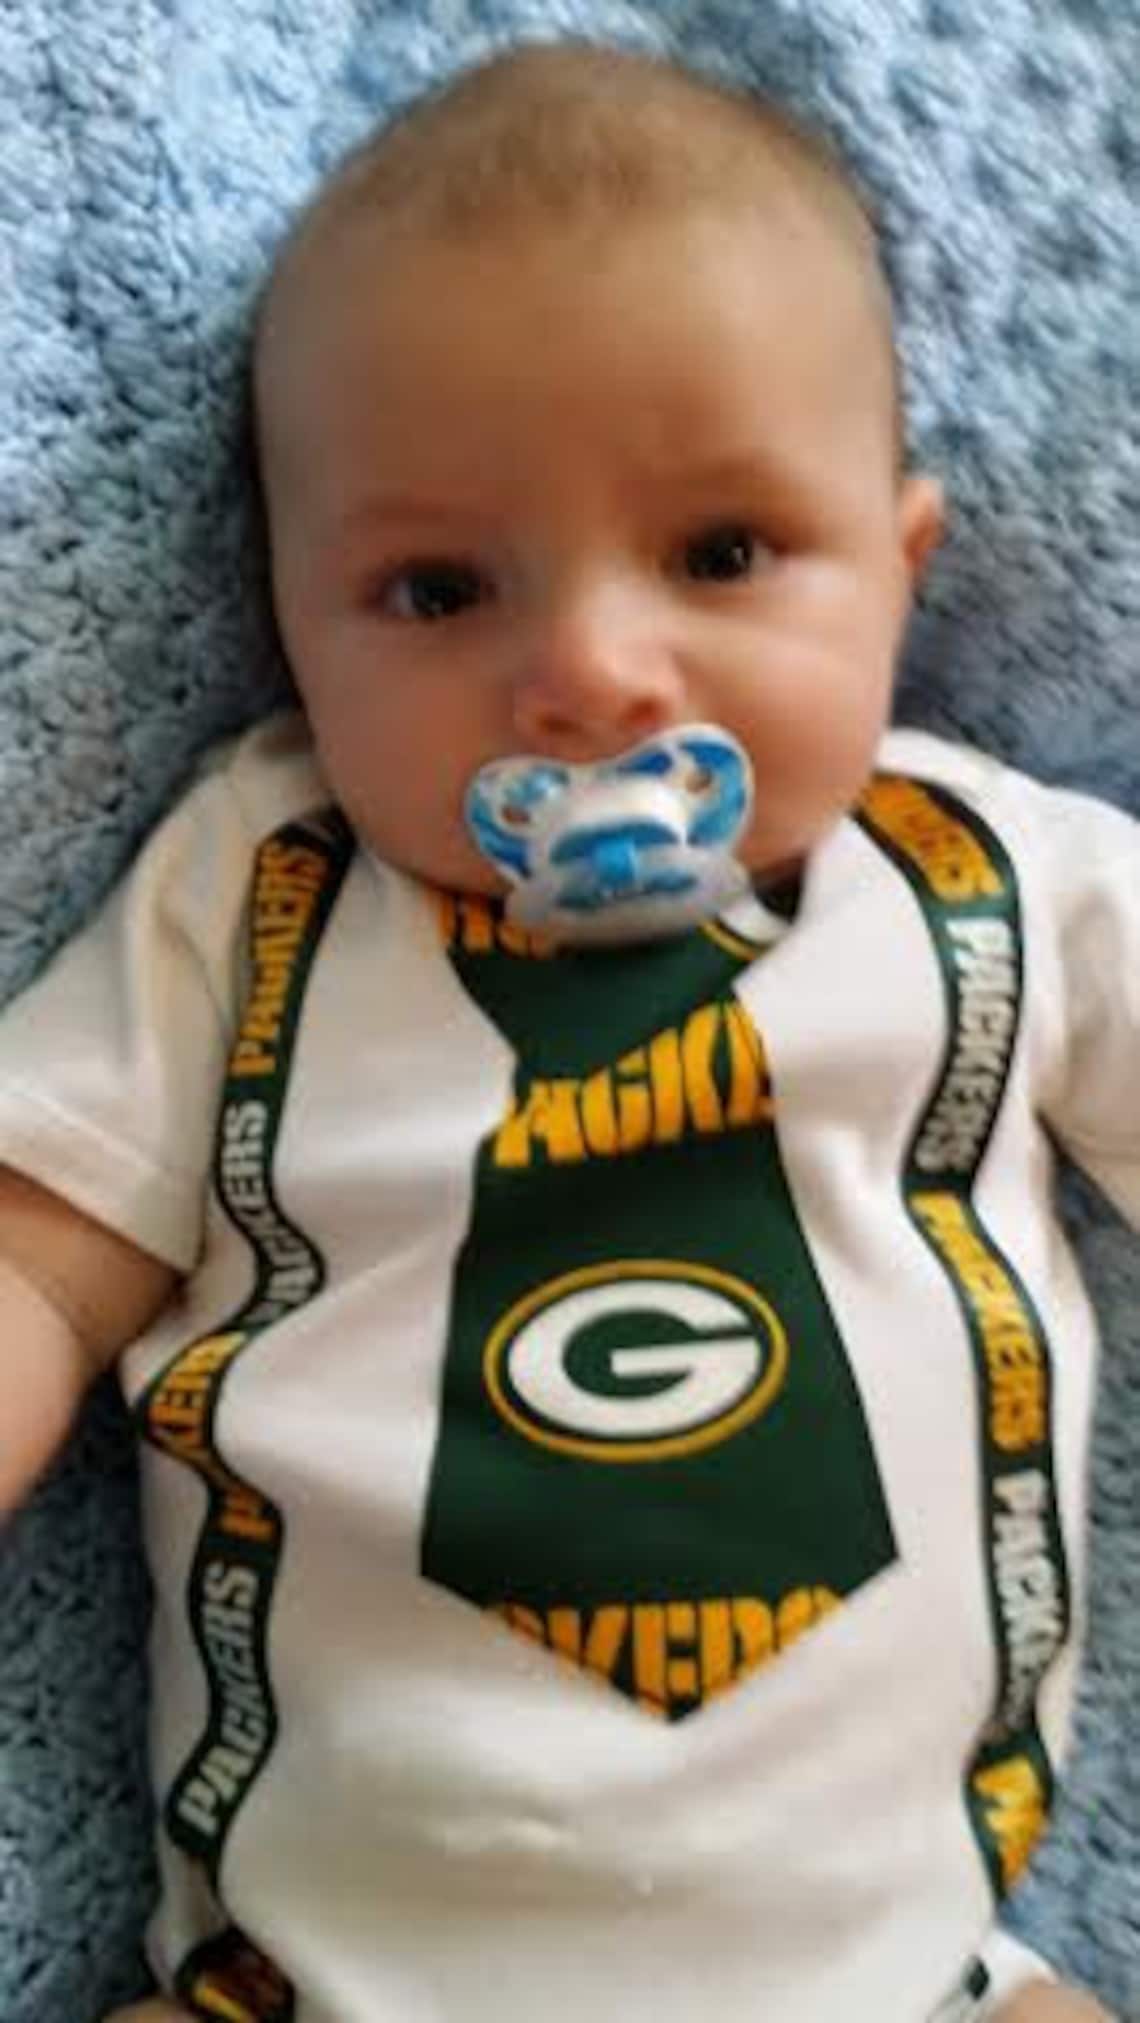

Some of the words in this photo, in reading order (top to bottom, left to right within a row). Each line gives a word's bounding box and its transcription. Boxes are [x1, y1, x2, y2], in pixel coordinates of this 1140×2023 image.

[915, 918, 1017, 1171] PACKERS
[508, 1280, 761, 1435] G
[909, 1191, 1046, 1451] PACKERS
[176, 1561, 266, 1836] PACKERS
